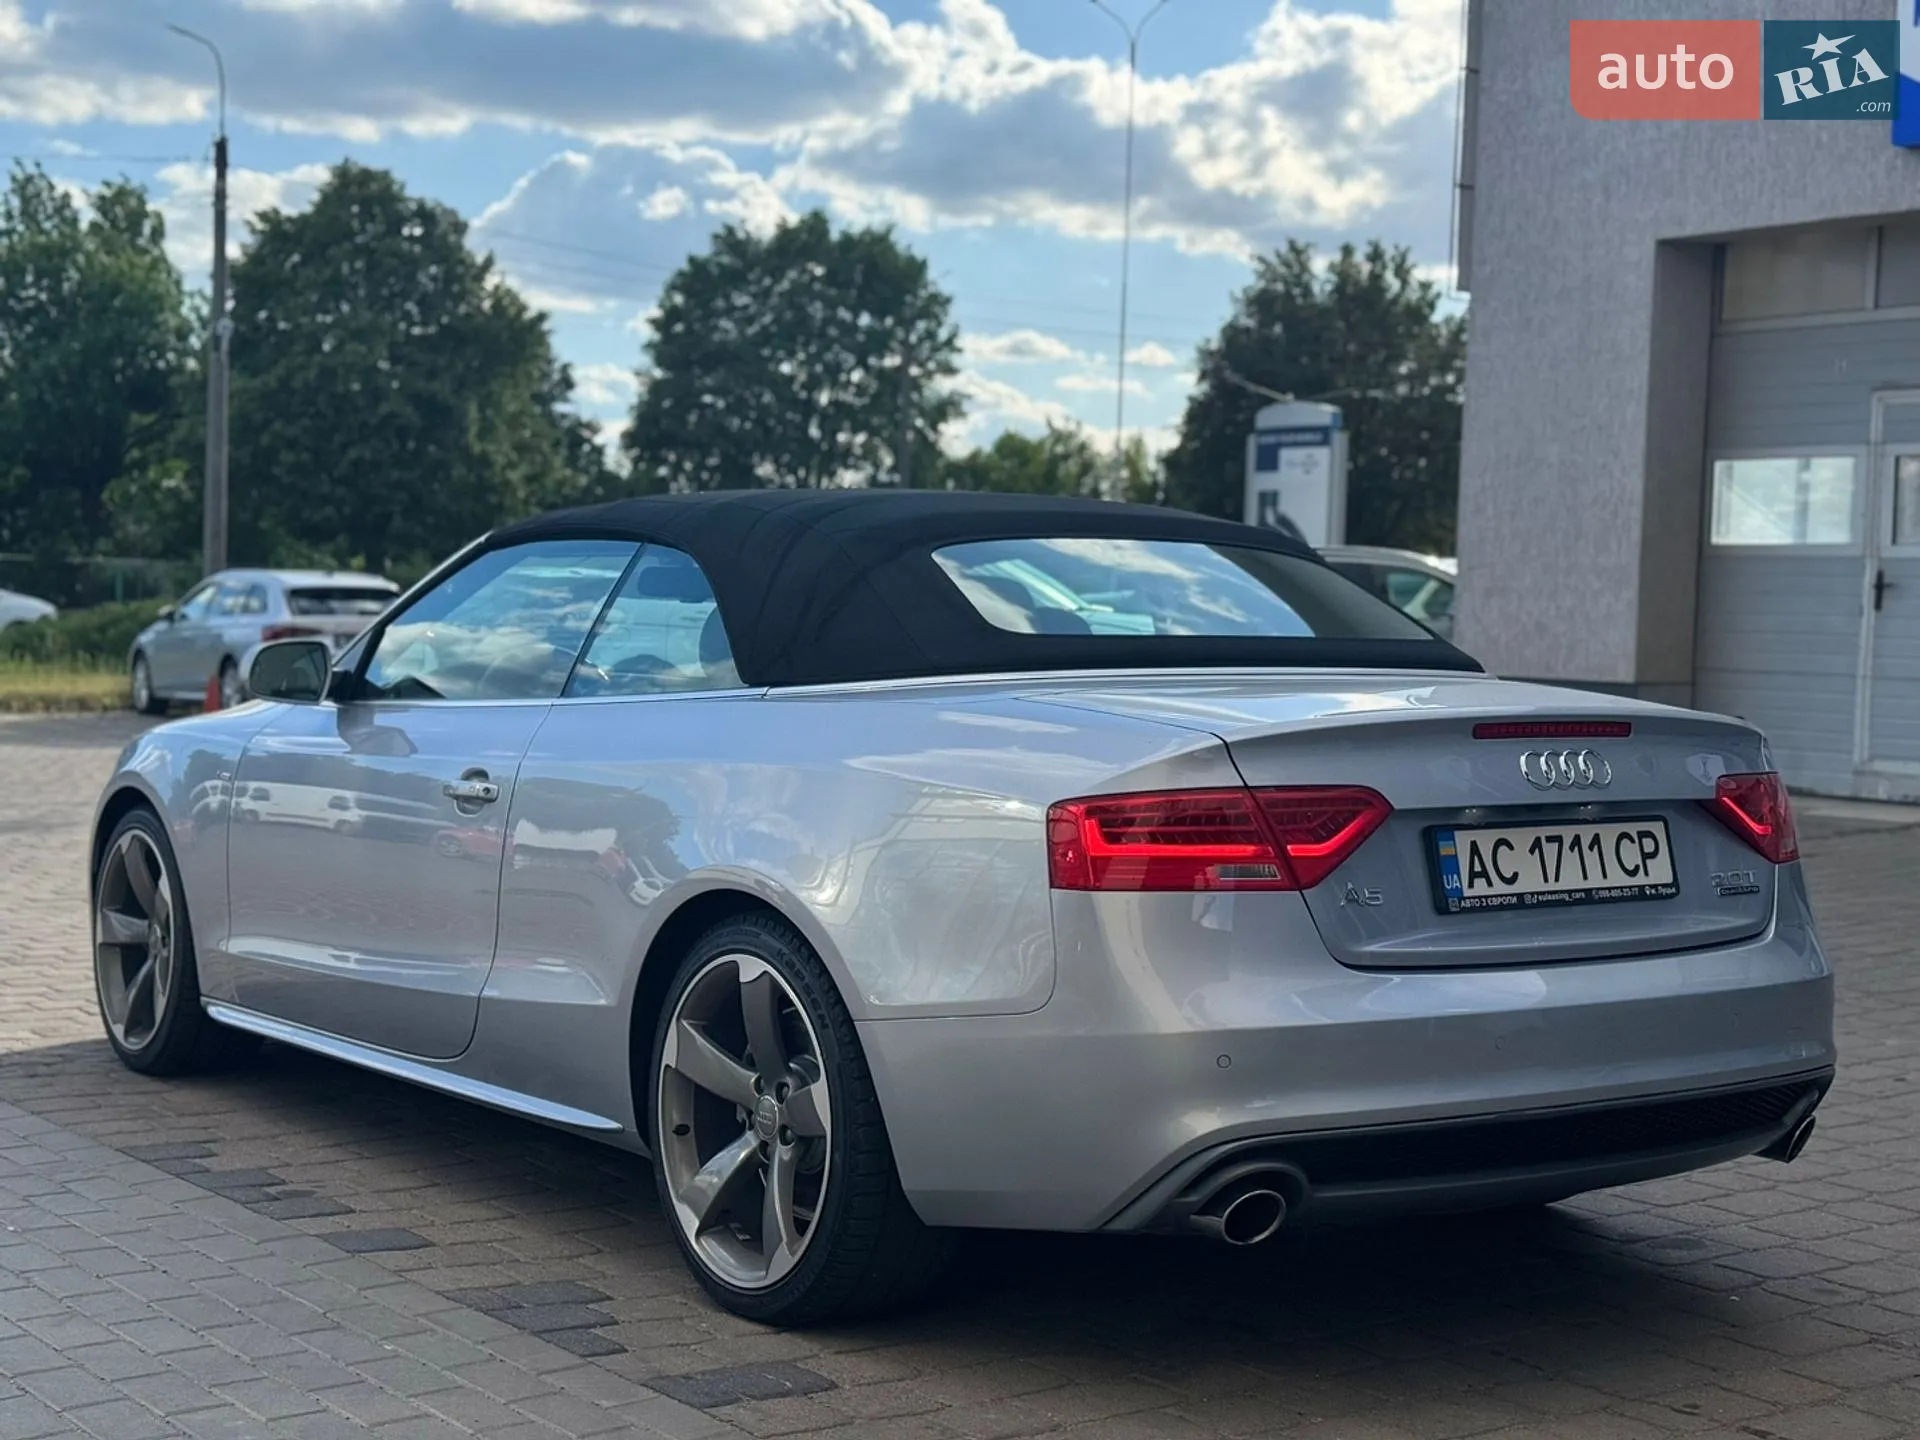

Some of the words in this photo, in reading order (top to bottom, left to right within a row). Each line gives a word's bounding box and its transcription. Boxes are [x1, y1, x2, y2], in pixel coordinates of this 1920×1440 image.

[1467, 837, 1519, 889] AC
[1528, 833, 1608, 884] 1711
[1615, 830, 1660, 878] CP
[1340, 880, 1384, 906] A5
[1442, 873, 1463, 889] UA
